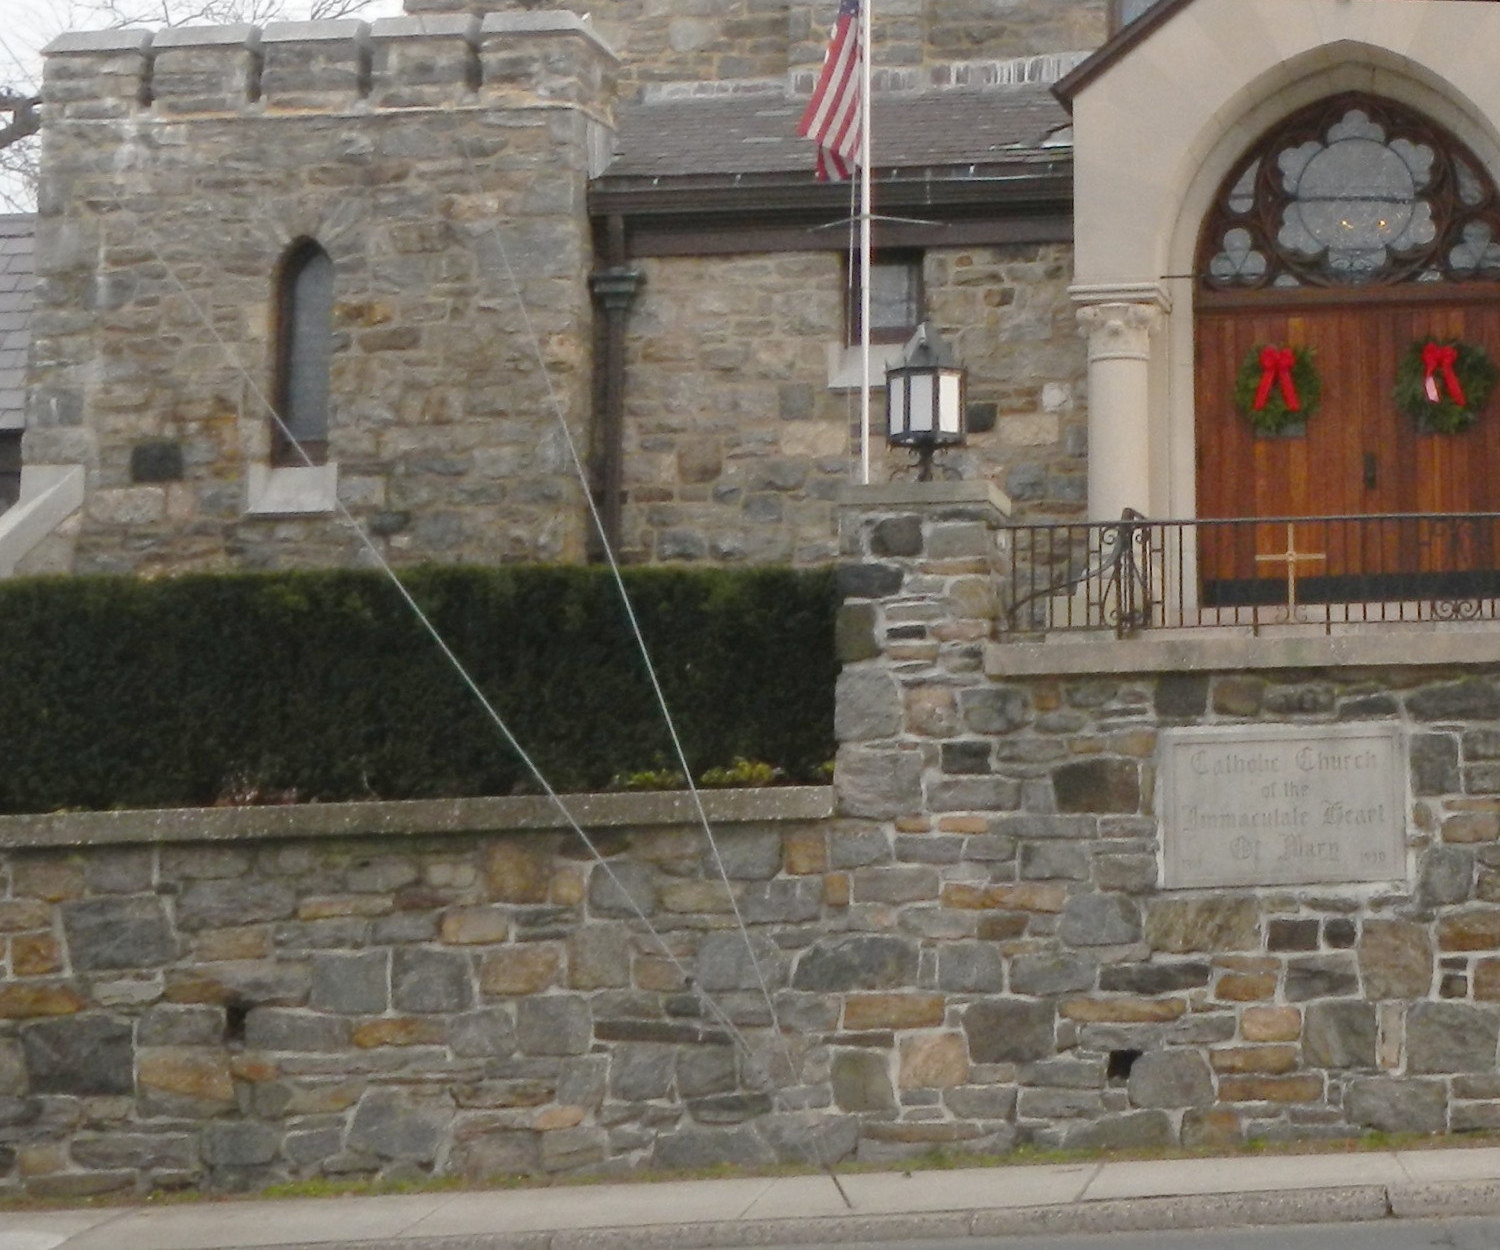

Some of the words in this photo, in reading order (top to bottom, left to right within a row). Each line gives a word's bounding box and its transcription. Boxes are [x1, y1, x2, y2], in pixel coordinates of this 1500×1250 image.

[1190, 750, 1279, 776] Catholic
[1295, 746, 1377, 772] Church
[1262, 781, 1276, 798] of
[1284, 780, 1310, 797] the
[1181, 803, 1309, 832] Immaculate
[1321, 799, 1386, 829] Heart
[1231, 835, 1261, 865] Of
[1278, 833, 1341, 862] Mary
